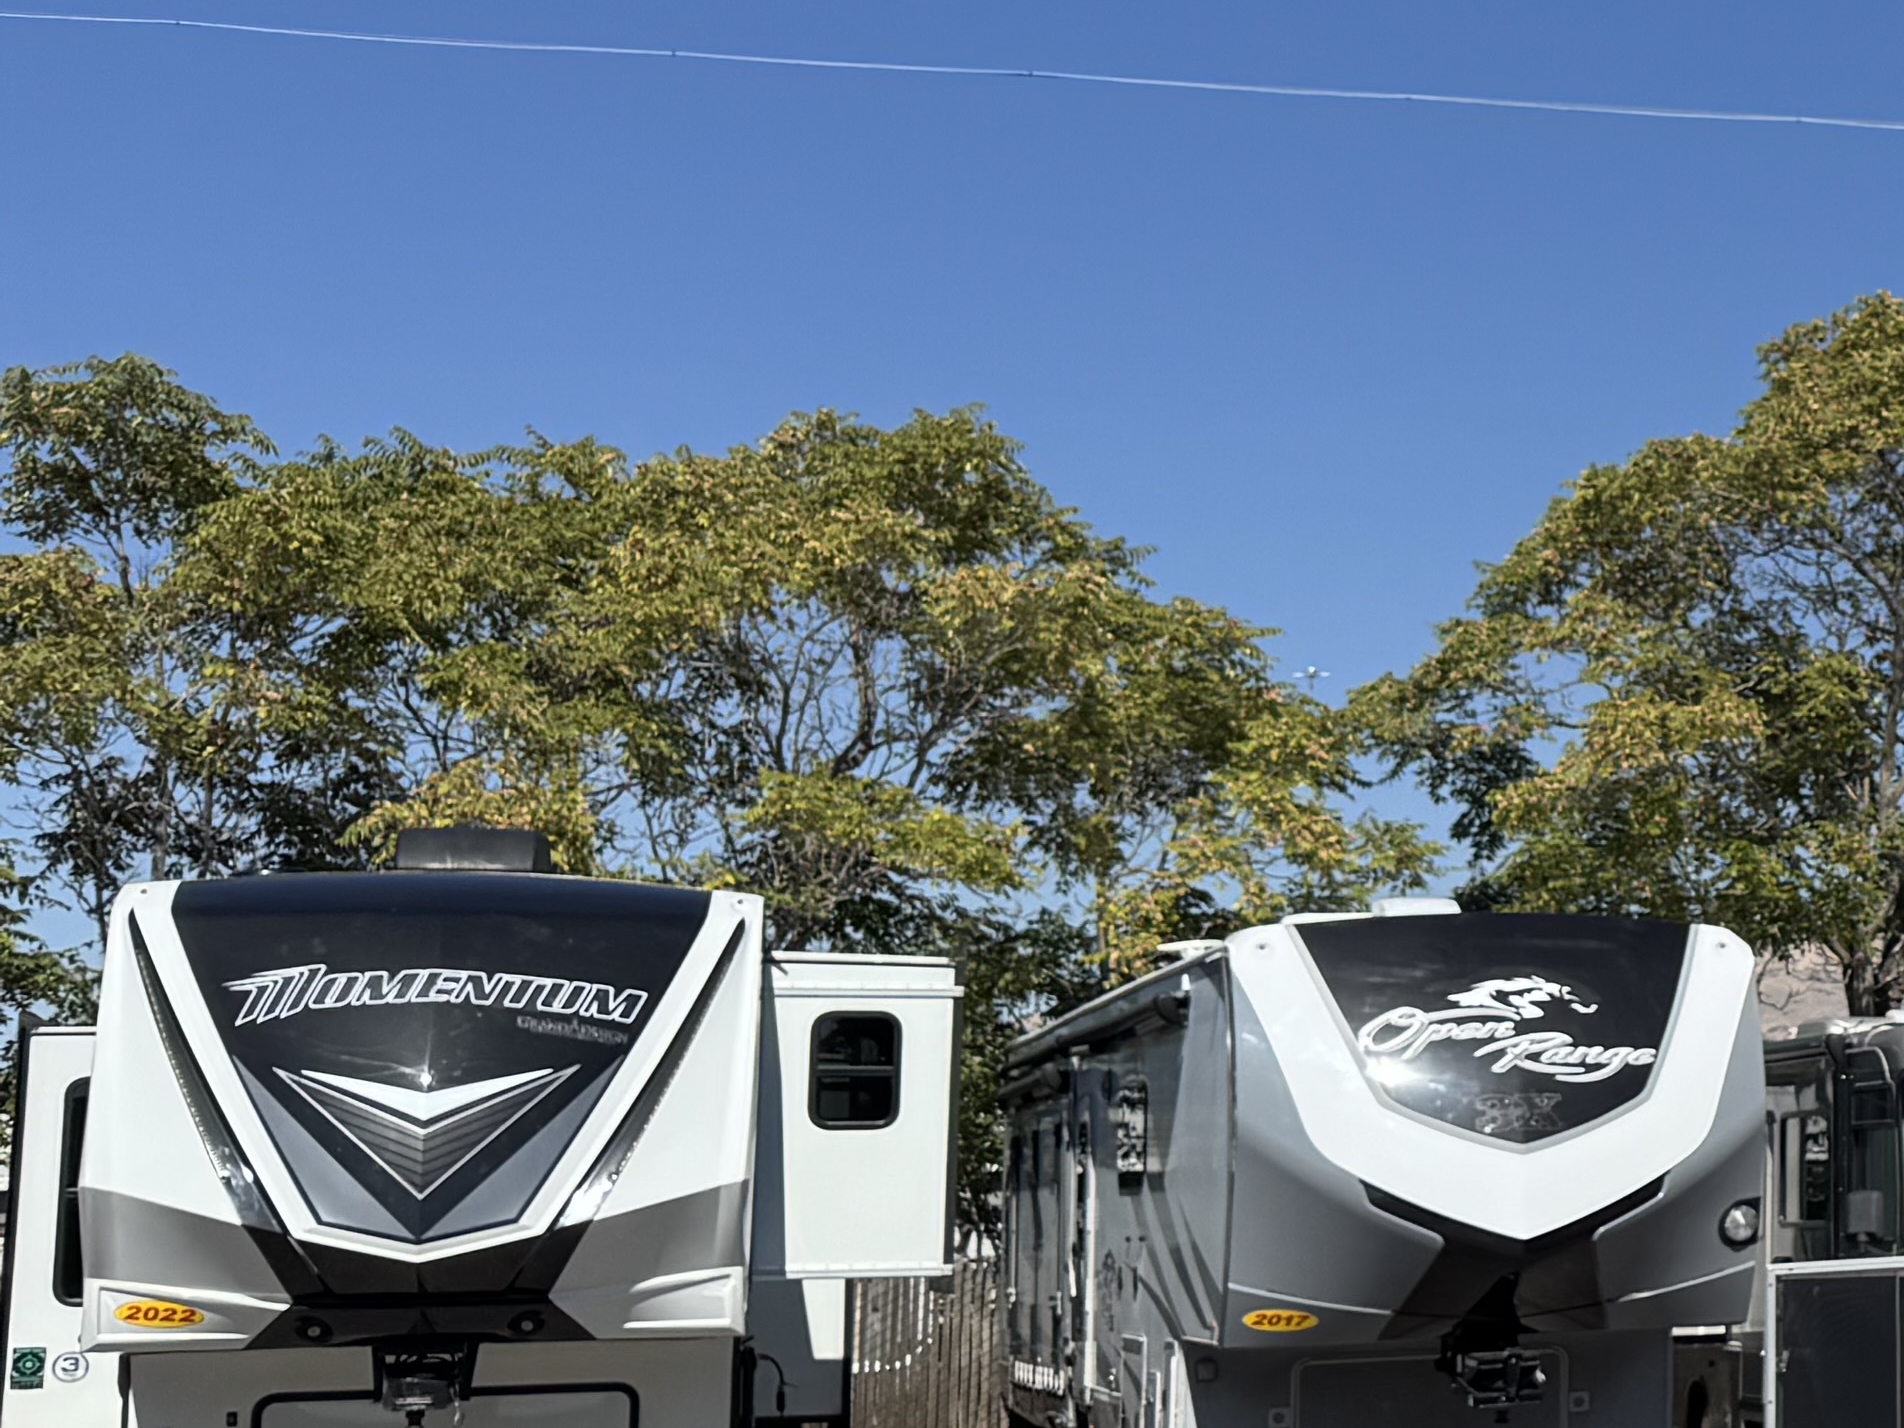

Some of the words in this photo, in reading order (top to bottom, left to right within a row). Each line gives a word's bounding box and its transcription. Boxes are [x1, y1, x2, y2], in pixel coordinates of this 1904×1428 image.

[222, 964, 649, 1027] MOMENTUM
[1358, 1006, 1521, 1061] Open
[1473, 1032, 1657, 1083] Range
[123, 1305, 198, 1323] 2022
[1250, 1313, 1311, 1327] 2017
[61, 1357, 80, 1373] 3
